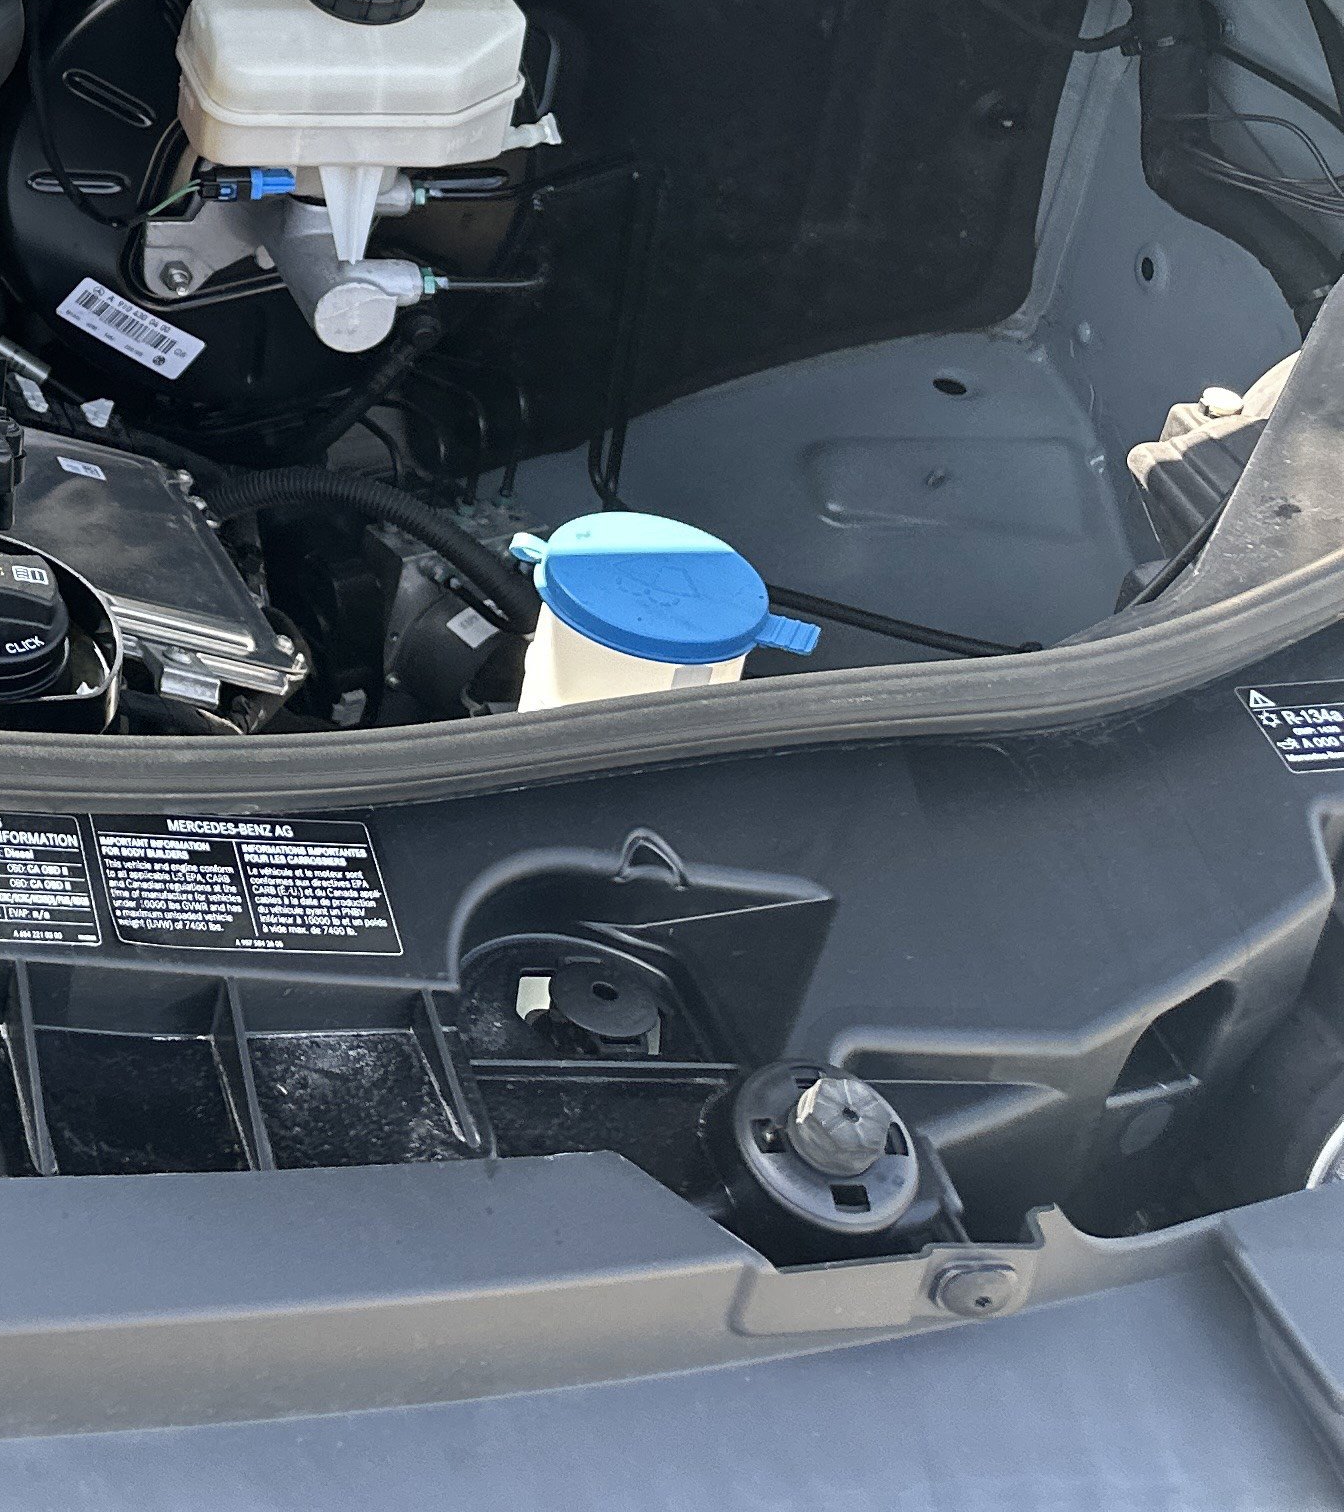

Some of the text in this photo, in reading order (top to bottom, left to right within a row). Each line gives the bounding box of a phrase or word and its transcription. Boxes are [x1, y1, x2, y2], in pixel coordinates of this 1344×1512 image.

[5, 635, 45, 654] CLICK
[166, 819, 294, 838] MERCEDES-BENZ AG
[99, 836, 211, 852] IMPORTANT INFORMATION
[241, 844, 307, 856] INFORMATIONS
[101, 846, 190, 860] FOR BODY BUILDERS
[244, 854, 270, 864] POUR
[270, 854, 287, 865] LES
[26, 864, 41, 875] CA
[104, 858, 234, 874] This vehicle and engine conform
[106, 869, 116, 878] to
[128, 871, 171, 881] applicable
[205, 873, 231, 884] CARB
[247, 866, 258, 876] Le
[294, 869, 304, 878] et
[314, 870, 343, 879] moteur
[344, 870, 364, 880] sont
[29, 879, 44, 889] CA
[108, 879, 238, 894] and Canadian regulations at the
[249, 876, 370, 890] conformes aux directives EPA
[131, 889, 140, 898] of
[141, 891, 193, 901] manufacture
[194, 892, 206, 901] for
[207, 893, 242, 904] vehicles
[304, 887, 314, 897] et
[315, 888, 326, 897] du
[326, 888, 358, 898] Canada
[209, 903, 226, 913] and
[226, 903, 243, 914] has
[299, 897, 319, 907] date
[319, 898, 331, 907] de
[332, 897, 377, 909] production
[122, 908, 164, 919] maximum
[164, 910, 203, 921] unloaded
[203, 912, 234, 922] vehicle
[257, 905, 269, 914] du
[329, 908, 341, 917] un
[116, 918, 145, 929] weight
[174, 920, 183, 930] of
[185, 920, 208, 931] 7400
[351, 918, 364, 927] un
[269, 924, 288, 934] vide
[288, 926, 309, 935] max.
[310, 926, 322, 935] de
